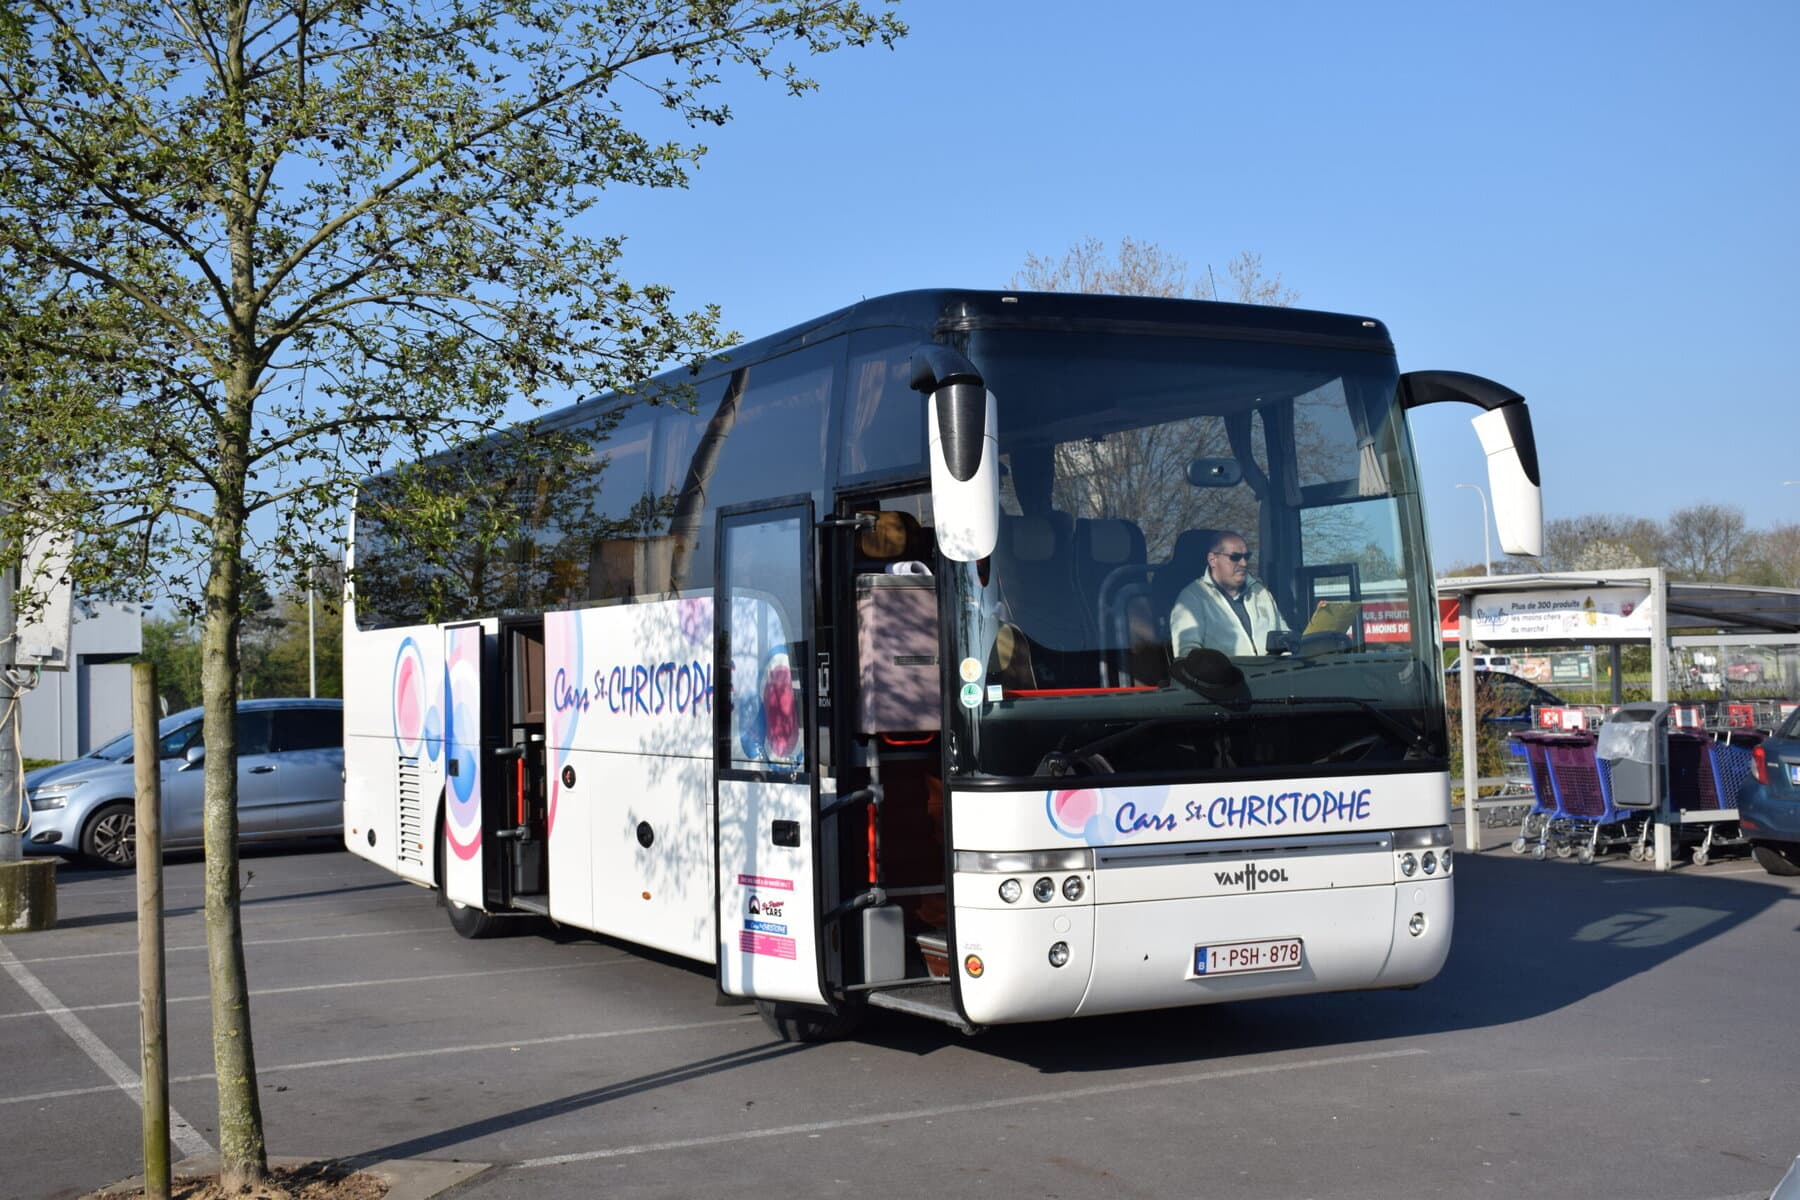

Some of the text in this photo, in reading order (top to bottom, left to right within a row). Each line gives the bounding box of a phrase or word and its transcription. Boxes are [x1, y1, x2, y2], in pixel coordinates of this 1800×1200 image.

[1511, 600, 1580, 610] Plus de 300 produits
[1511, 613, 1561, 622] les moins chers
[1371, 623, 1397, 633] MOINS
[1398, 623, 1409, 633] DE
[1511, 625, 1520, 633] du
[554, 667, 590, 713] Cars
[1115, 802, 1177, 834] Cars
[1207, 789, 1372, 829] CHRISTOPHE
[765, 907, 782, 917] CARS
